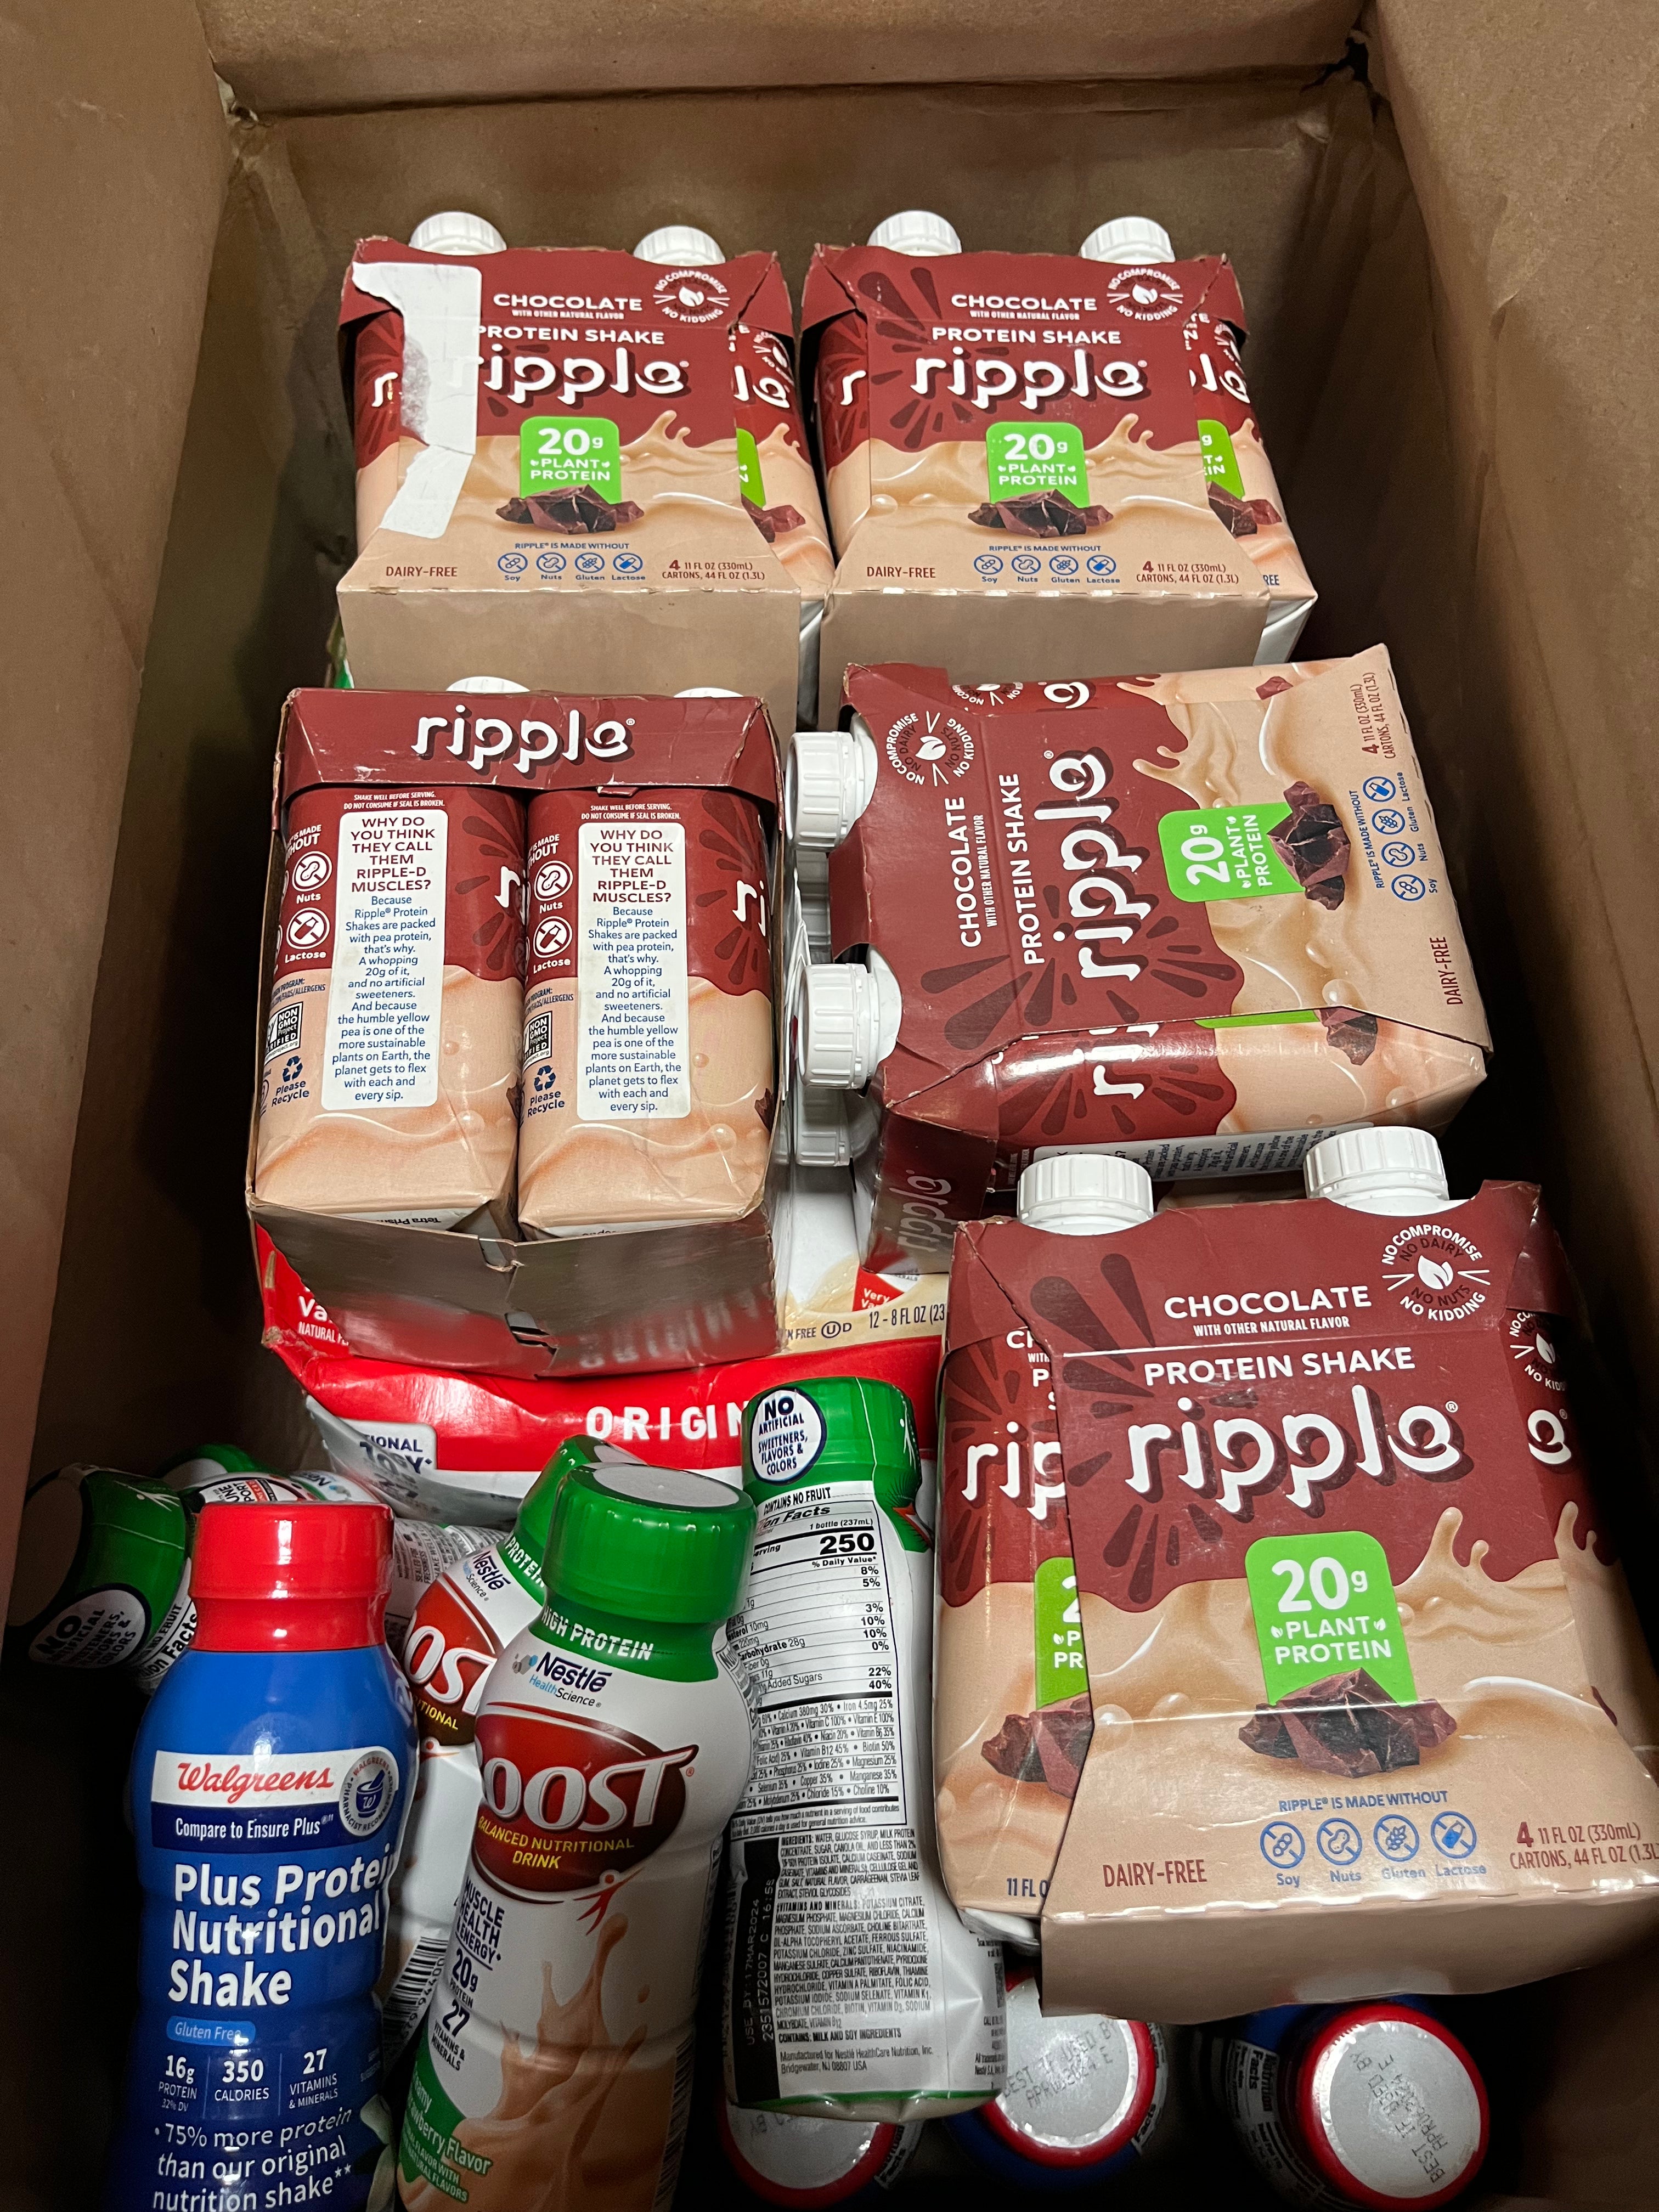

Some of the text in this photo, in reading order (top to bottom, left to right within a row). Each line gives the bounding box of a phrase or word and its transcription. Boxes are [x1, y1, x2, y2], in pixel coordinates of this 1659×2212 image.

[494, 294, 642, 311] CHOCOLATE
[951, 294, 1097, 311] CHOCOLATE
[585, 329, 665, 345] SHAKE
[932, 328, 1121, 344] PROTEIN SHAKE
[477, 343, 685, 405] ipple
[1003, 433, 1068, 461] 20g
[386, 566, 458, 578] DAIRY-FREE
[867, 566, 936, 579] DAIRY-FREE
[1350, 684, 1369, 714] (330mL)
[1358, 714, 1370, 725] OZ
[1361, 725, 1373, 733] FL
[1362, 744, 1379, 754] 4
[420, 799, 445, 807] BROKEN.
[362, 817, 425, 827] WHY DO
[1397, 772, 1437, 893] Soy Nuts Gluten Lactose
[351, 829, 435, 840] YOU THINK
[352, 842, 432, 853] THEY CALL
[1179, 824, 1230, 887] 20g
[1225, 826, 1246, 879] PLANT
[1243, 814, 1272, 887] PROTEIN
[370, 855, 414, 865] THEM
[998, 774, 1045, 965] PROTEIN SHAKE
[357, 867, 426, 878] RIPPLE-D
[945, 797, 981, 947] CHOCOLATE
[352, 879, 431, 892] MUSCLES?
[296, 892, 321, 904] Nuts
[371, 896, 412, 905] Because
[393, 906, 427, 917] Protein
[346, 921, 380, 931] Shakes
[400, 917, 436, 931] packed
[349, 931, 431, 944] with pea protein,
[394, 944, 415, 953] why.
[285, 950, 326, 963] Lactose
[1429, 936, 1464, 1006] DAIRY-FREE
[272, 1089, 309, 1107] Recycle
[276, 1080, 306, 1095] Please
[1381, 1224, 1483, 1265] NO COMPROMISE
[1164, 1285, 1372, 1319] CHOCOLATE
[1400, 1291, 1486, 1322] NO KIDDING
[796, 1327, 816, 1340] FREE
[869, 1311, 879, 1329] 12
[891, 1308, 897, 1326] 8
[900, 1307, 911, 1324] FL
[914, 1306, 926, 1323] OZ
[1193, 1316, 1350, 1337] WITH OTHER NATURAL FLAVOR
[1144, 1346, 1415, 1387] PROTEIN SHAKE
[764, 1396, 794, 1421] NO
[758, 1412, 804, 1436] ARTIFICIAL
[758, 1429, 808, 1454] SWEETENERS,
[761, 1444, 803, 1465] FLAVORS &
[767, 1457, 797, 1475] COLORS
[820, 1533, 874, 1555] 250
[823, 1558, 845, 1566] Daily
[861, 1566, 879, 1575] 8%
[862, 1578, 881, 1587] 5%
[1271, 1555, 1369, 1614] 20g
[540, 1605, 654, 1661] HIGH PROTEIN
[1285, 1615, 1370, 1640] PLANT
[1274, 1638, 1393, 1666] PROTEIN
[868, 1667, 891, 1677] 22%
[868, 1680, 891, 1689] 40%
[177, 1762, 334, 1804] Walgreens
[482, 1744, 699, 1833] OOST
[1331, 1797, 1343, 1809] IS
[1345, 1794, 1385, 1809] MADE
[1386, 1790, 1448, 1805] WITHOUT
[176, 1818, 226, 1840] Compare
[230, 1821, 243, 1838] to
[247, 1819, 289, 1838] Ensure
[478, 1816, 635, 1853] BALANCED NUTRITIONAL
[1517, 1821, 1640, 1848] 4 11 FL OZ (330mL)
[512, 1850, 563, 1869] DRINK
[1510, 1846, 1627, 1870] CARTONS, 44 FL OZ
[175, 1863, 261, 1906] Plus
[1102, 1858, 1207, 1889] DAIRY-FREE
[1277, 1863, 1487, 1888] Soy Nuts Gluten Lactose
[172, 1889, 380, 1955] Nutritional
[452, 1949, 478, 1993] 20g
[168, 1959, 292, 2007] Shake
[448, 1977, 474, 2009] PROTEIN
[442, 1999, 471, 2038] 27
[175, 2022, 211, 2040] Gluten
[165, 2049, 328, 2084] 16g 350 27
[159, 2073, 338, 2101] PROTEIN CALORIES VITAMINS
[289, 2088, 338, 2109] & MINERALS
[214, 2128, 273, 2148] more
[280, 2107, 352, 2147] protein
